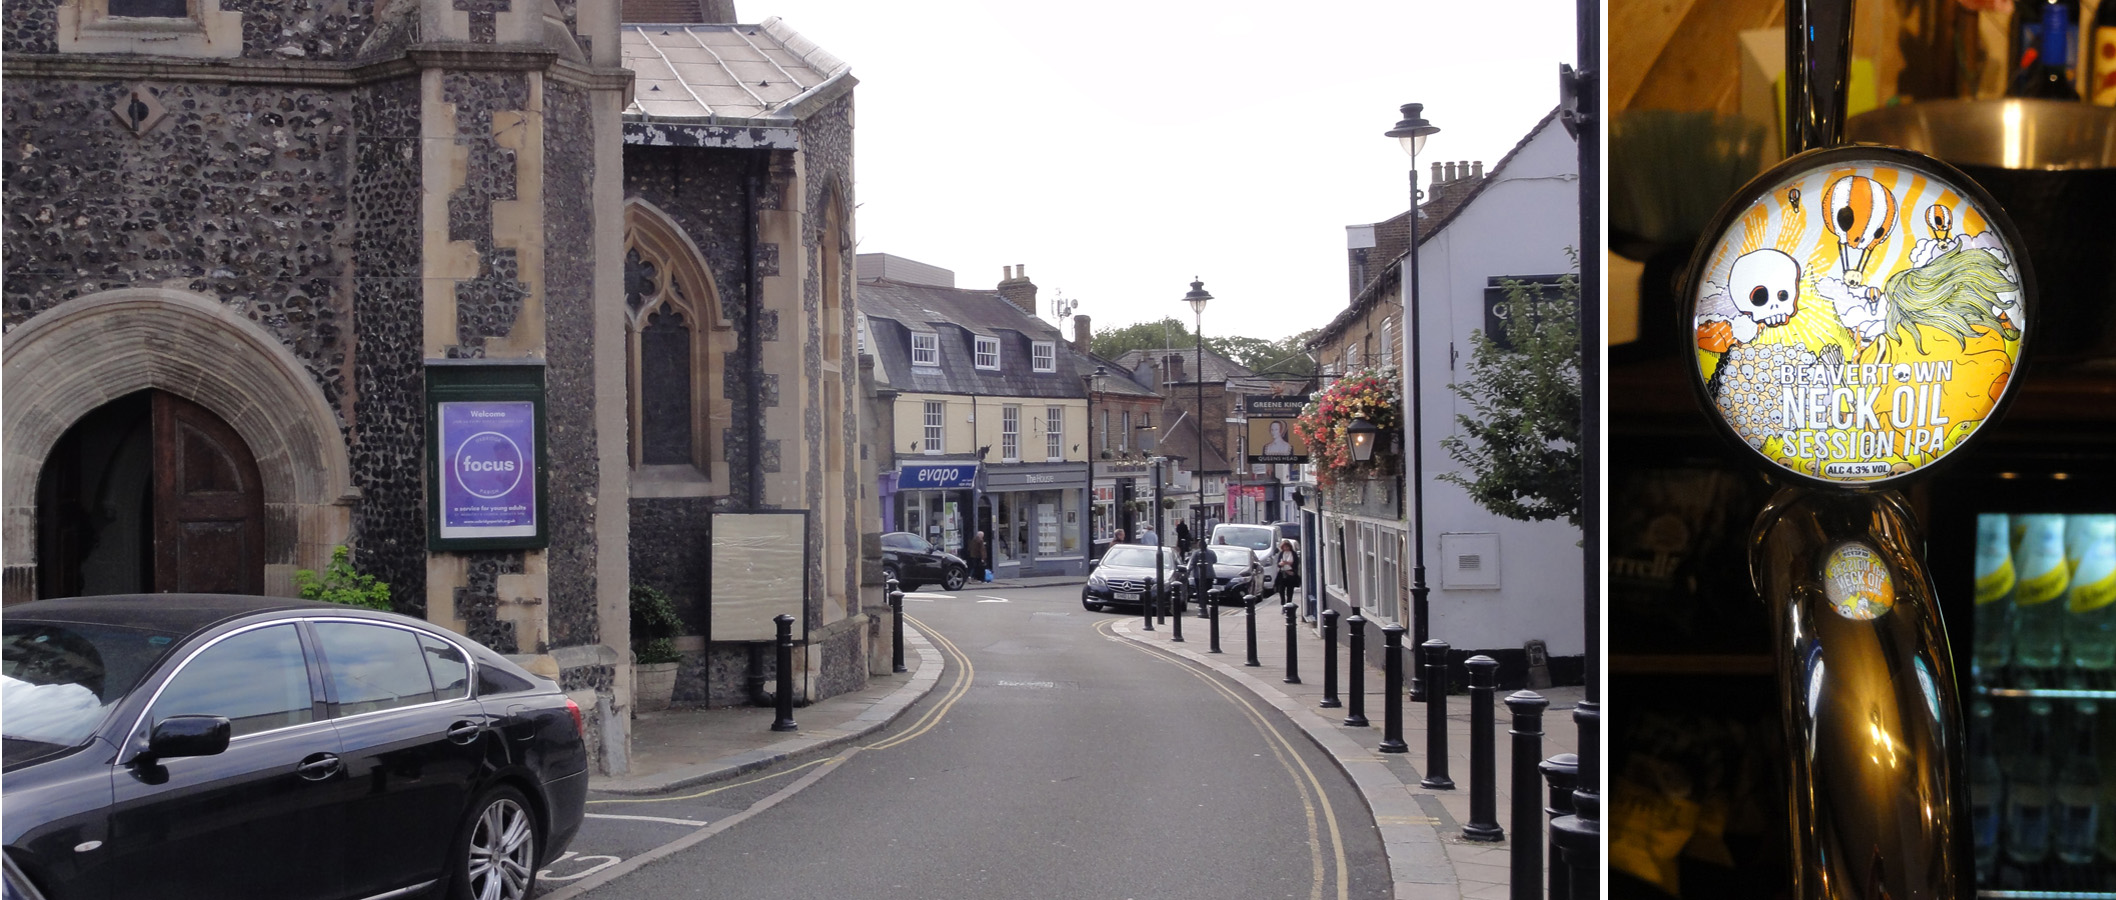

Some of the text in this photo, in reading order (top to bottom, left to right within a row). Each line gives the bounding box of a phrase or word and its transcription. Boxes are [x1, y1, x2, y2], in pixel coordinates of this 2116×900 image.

[470, 410, 506, 418] Welcome
[1782, 384, 1949, 430] NECK OIL
[1782, 426, 1944, 459] SESSION IPA
[463, 455, 515, 472] focus
[1827, 465, 1888, 474] ALC 4.3% VOL
[918, 468, 959, 486] evapo
[1025, 474, 1036, 483] The
